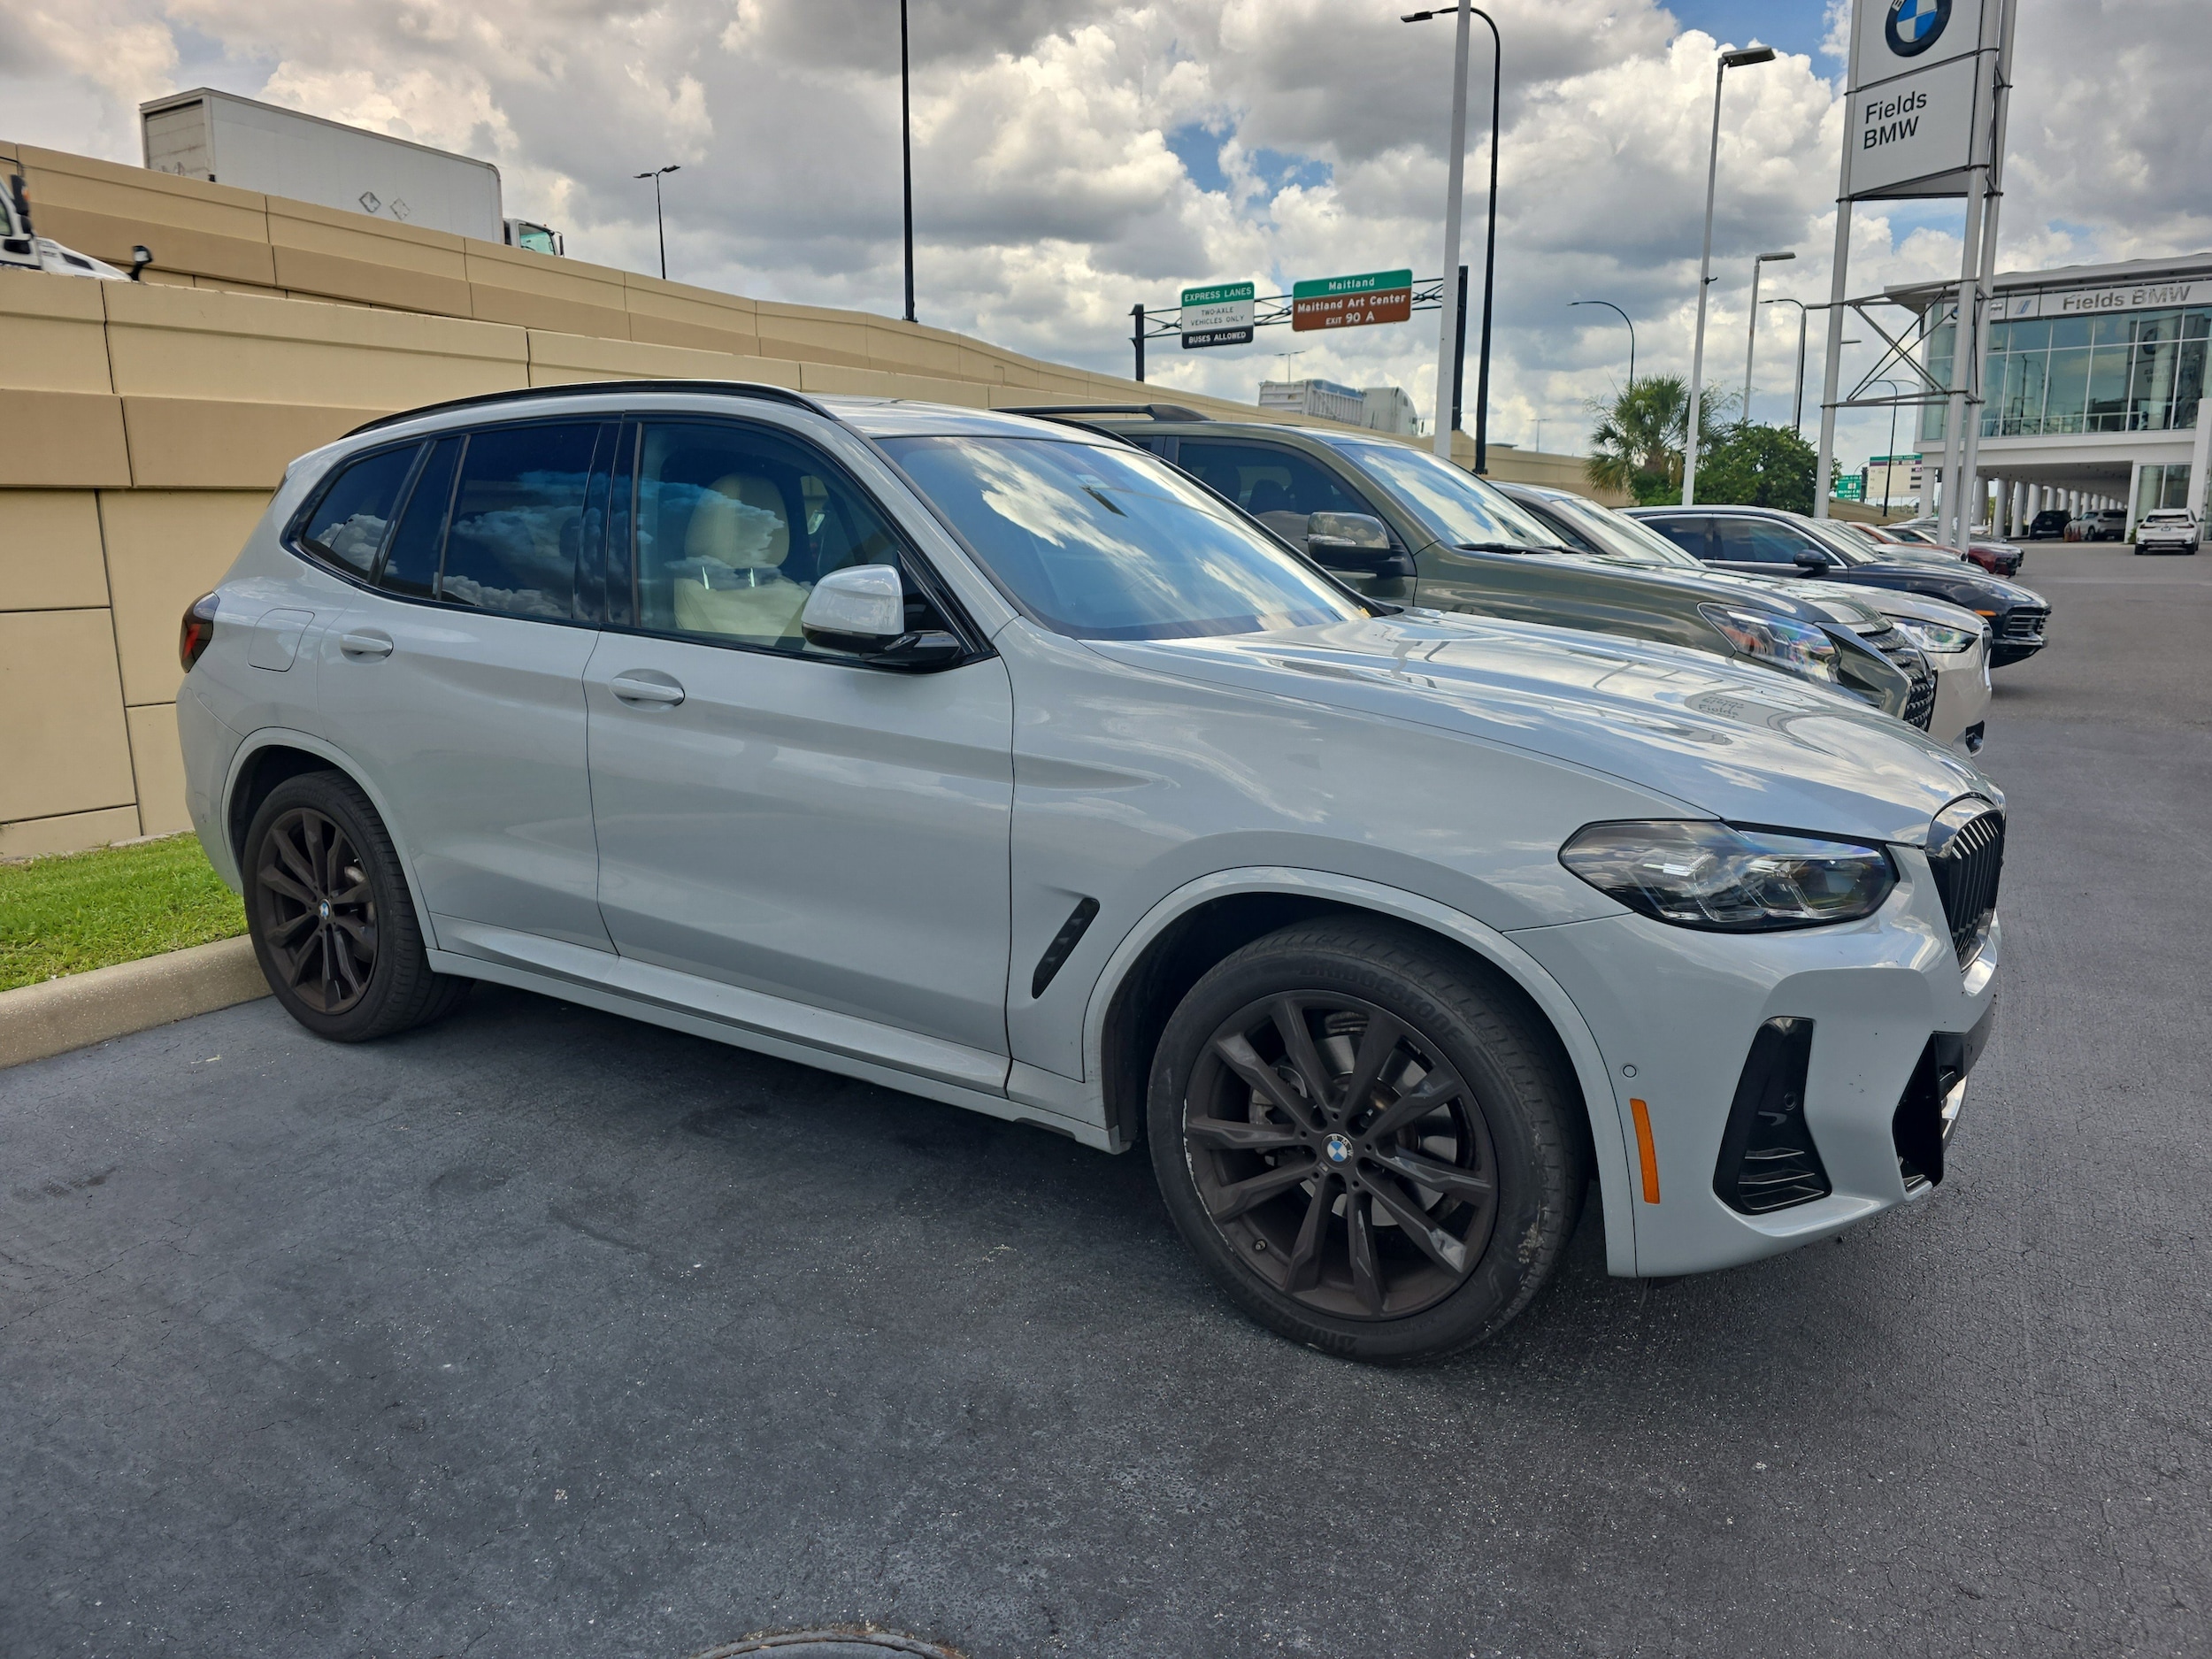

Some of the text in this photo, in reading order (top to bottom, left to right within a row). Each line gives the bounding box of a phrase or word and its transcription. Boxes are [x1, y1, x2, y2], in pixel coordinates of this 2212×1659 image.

[1865, 91, 1927, 124] Fields
[1863, 116, 1919, 150] BMW
[1328, 277, 1375, 291] Maitland
[1184, 287, 1252, 303] EXPRESS LANES
[1297, 294, 1406, 313] Maitland Art Center
[2062, 285, 2192, 310] Fields BMW
[1191, 318, 1223, 326] VEHICLES
[1325, 311, 1375, 326] EXIT 90 A
[1188, 332, 1247, 344] BUSES ALLOWED
[1296, 956, 1465, 1045] BRIDGESTONE
[1331, 1134, 1354, 1156] BMW
